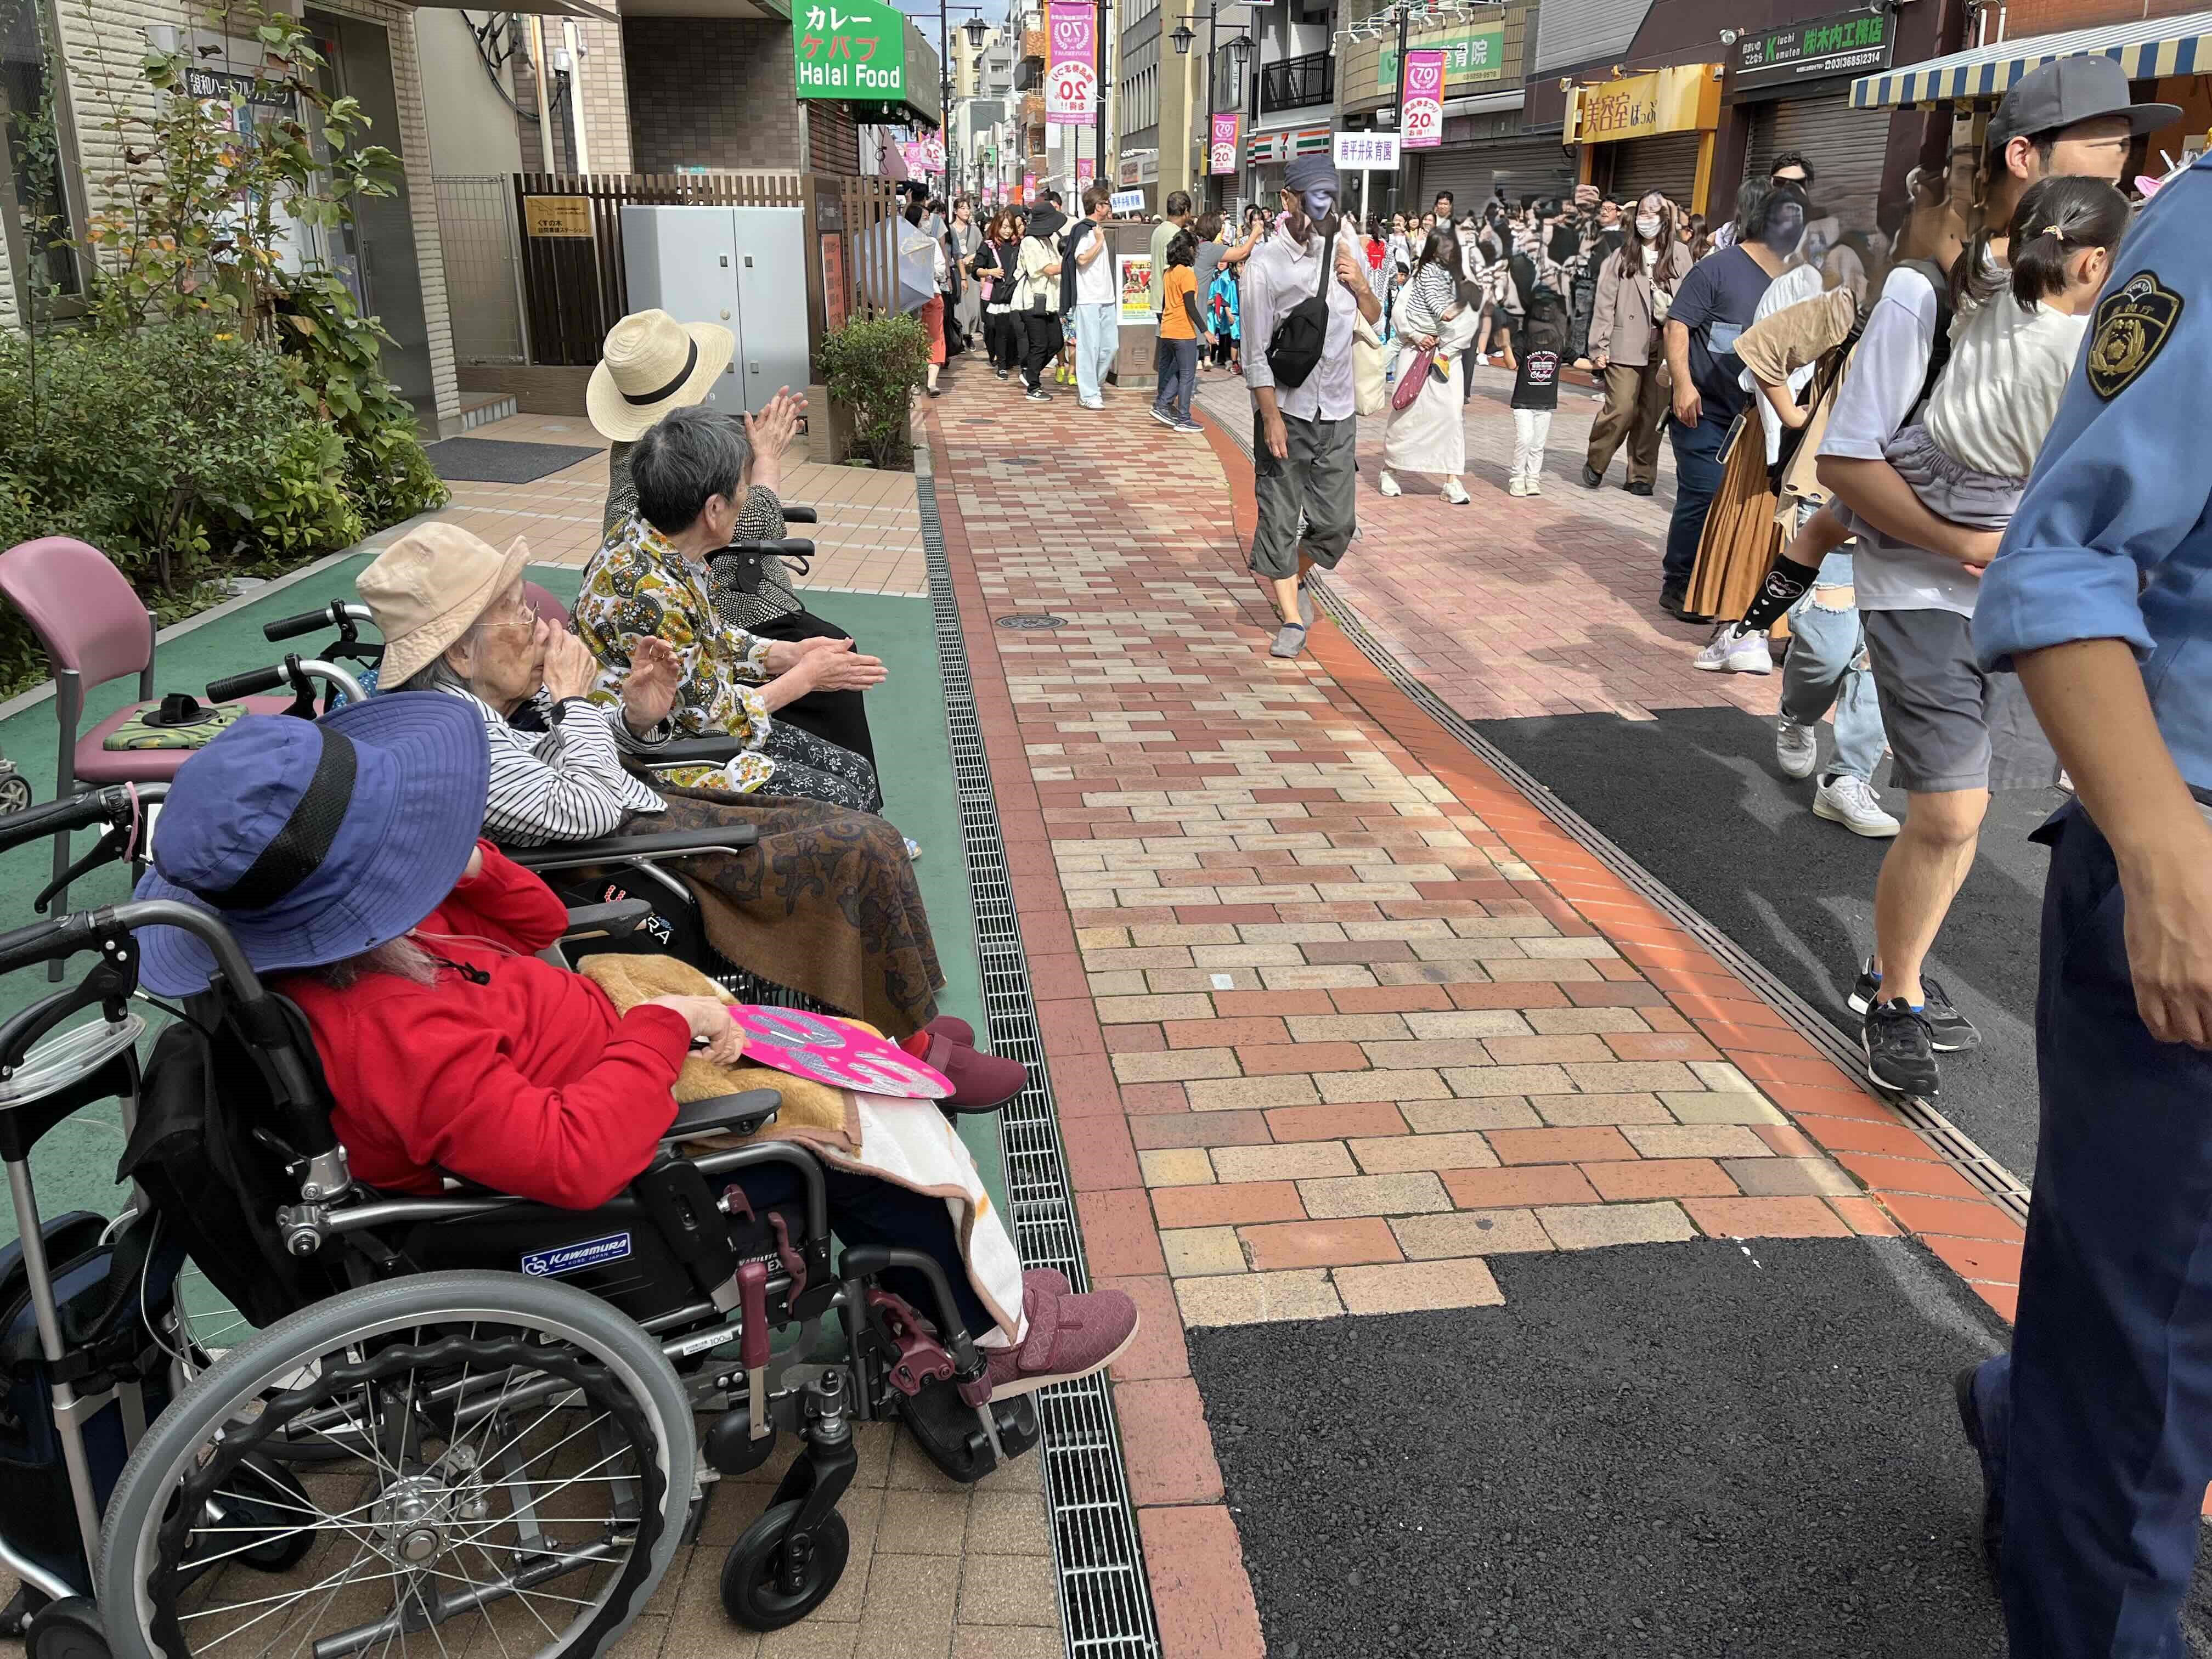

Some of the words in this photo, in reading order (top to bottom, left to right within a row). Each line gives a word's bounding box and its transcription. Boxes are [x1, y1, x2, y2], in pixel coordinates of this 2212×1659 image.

[805, 5, 872, 31] カレー
[800, 61, 848, 86] Halal
[855, 64, 900, 88] Food
[1416, 67, 1433, 80] 70
[1584, 92, 1630, 134] 美容室
[1341, 139, 1392, 161] 南平井保育園
[2129, 282, 2149, 293] TOKYO
[549, 1239, 627, 1265] KAWAMURA
[588, 1252, 608, 1261] JAPAN
